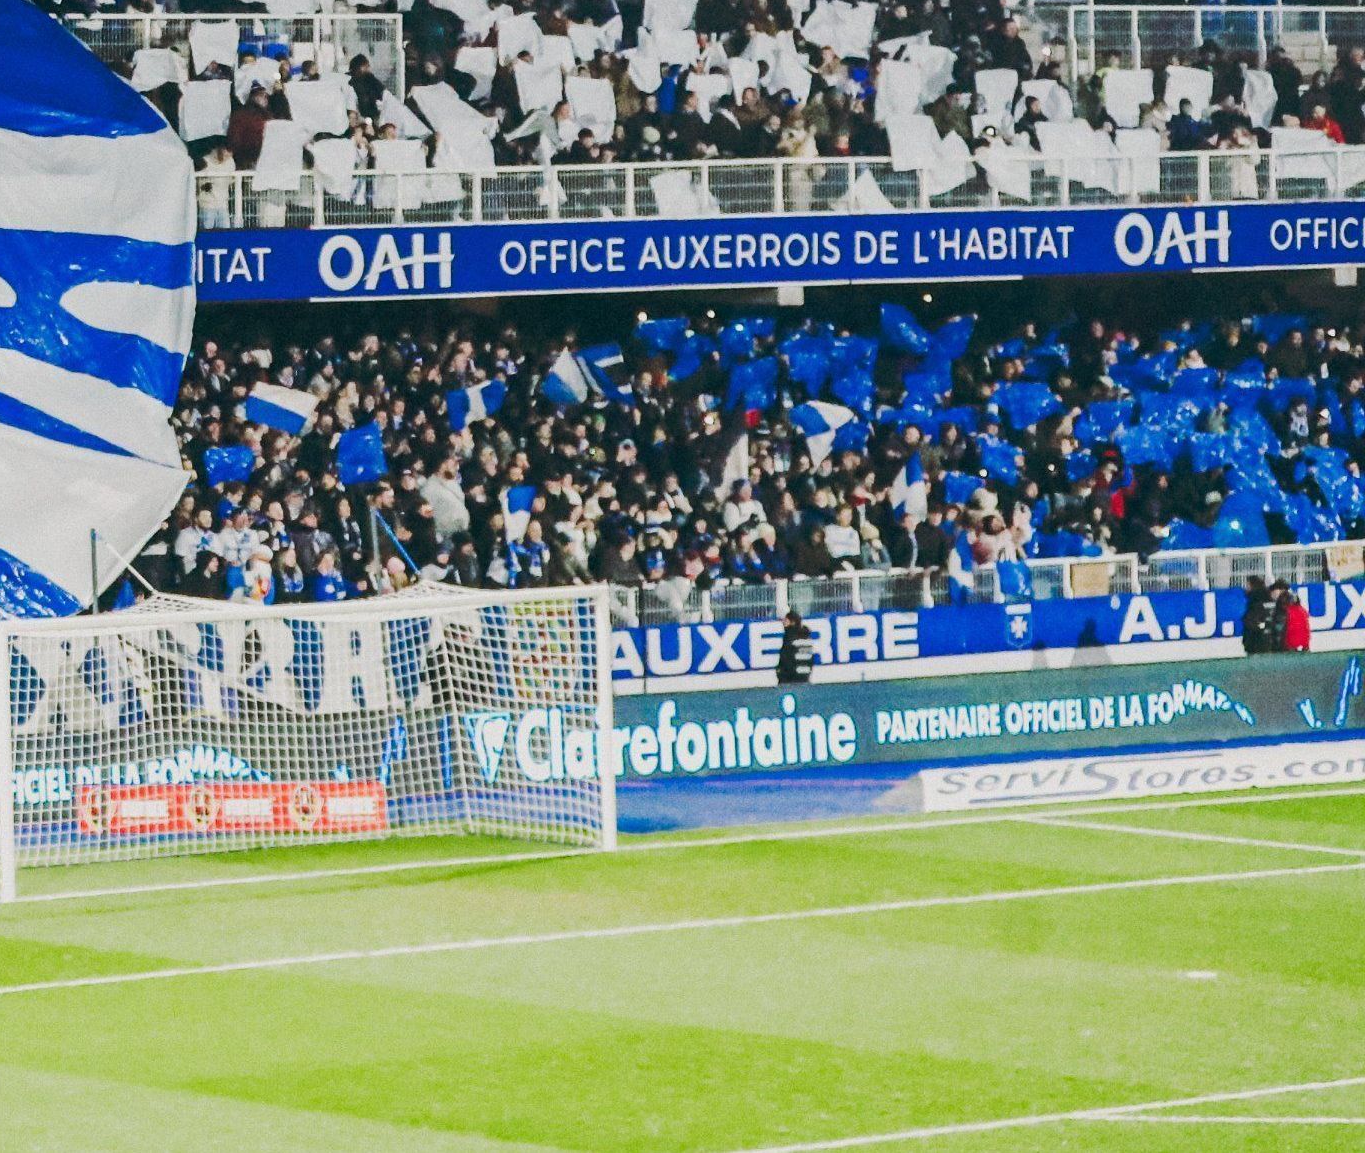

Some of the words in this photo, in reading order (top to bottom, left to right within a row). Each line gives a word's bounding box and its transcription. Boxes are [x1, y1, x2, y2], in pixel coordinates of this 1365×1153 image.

[196, 246, 273, 286] ITAT
[317, 231, 456, 292] OAH
[498, 237, 627, 277] OFFICE
[638, 231, 841, 272] AUXERROIS
[854, 230, 899, 266] DE
[913, 224, 1075, 266] L'HABITAT
[1113, 209, 1232, 268] OAH
[1269, 214, 1365, 252] OFFIC
[514, 693, 858, 783] Clarefontaine
[875, 701, 1002, 744] PARTENAIRE
[1004, 697, 1087, 737] OFFICIEL
[1088, 696, 1115, 730] DE
[1118, 694, 1145, 728] LA
